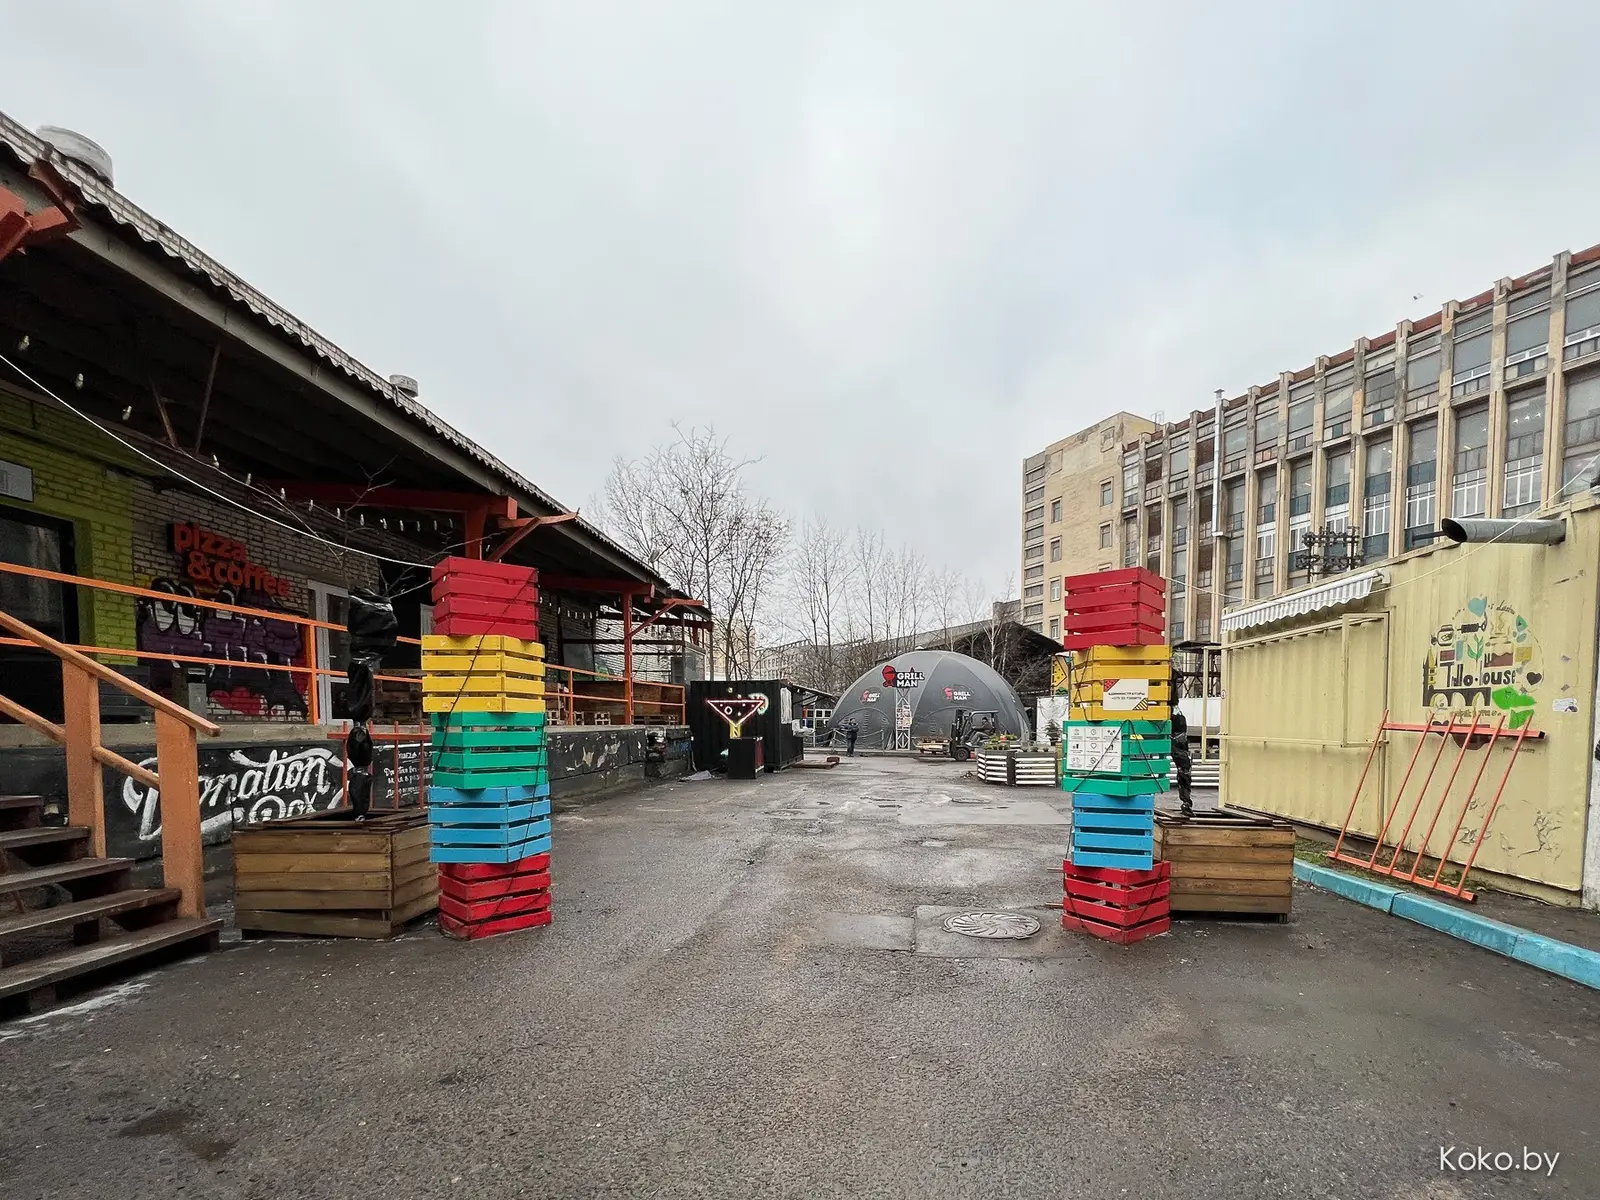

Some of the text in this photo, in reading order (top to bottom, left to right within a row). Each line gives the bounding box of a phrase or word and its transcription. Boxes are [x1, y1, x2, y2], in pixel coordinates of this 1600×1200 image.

[173, 522, 249, 562] pizza
[896, 672, 925, 681] GRILL
[896, 680, 919, 688] MAN
